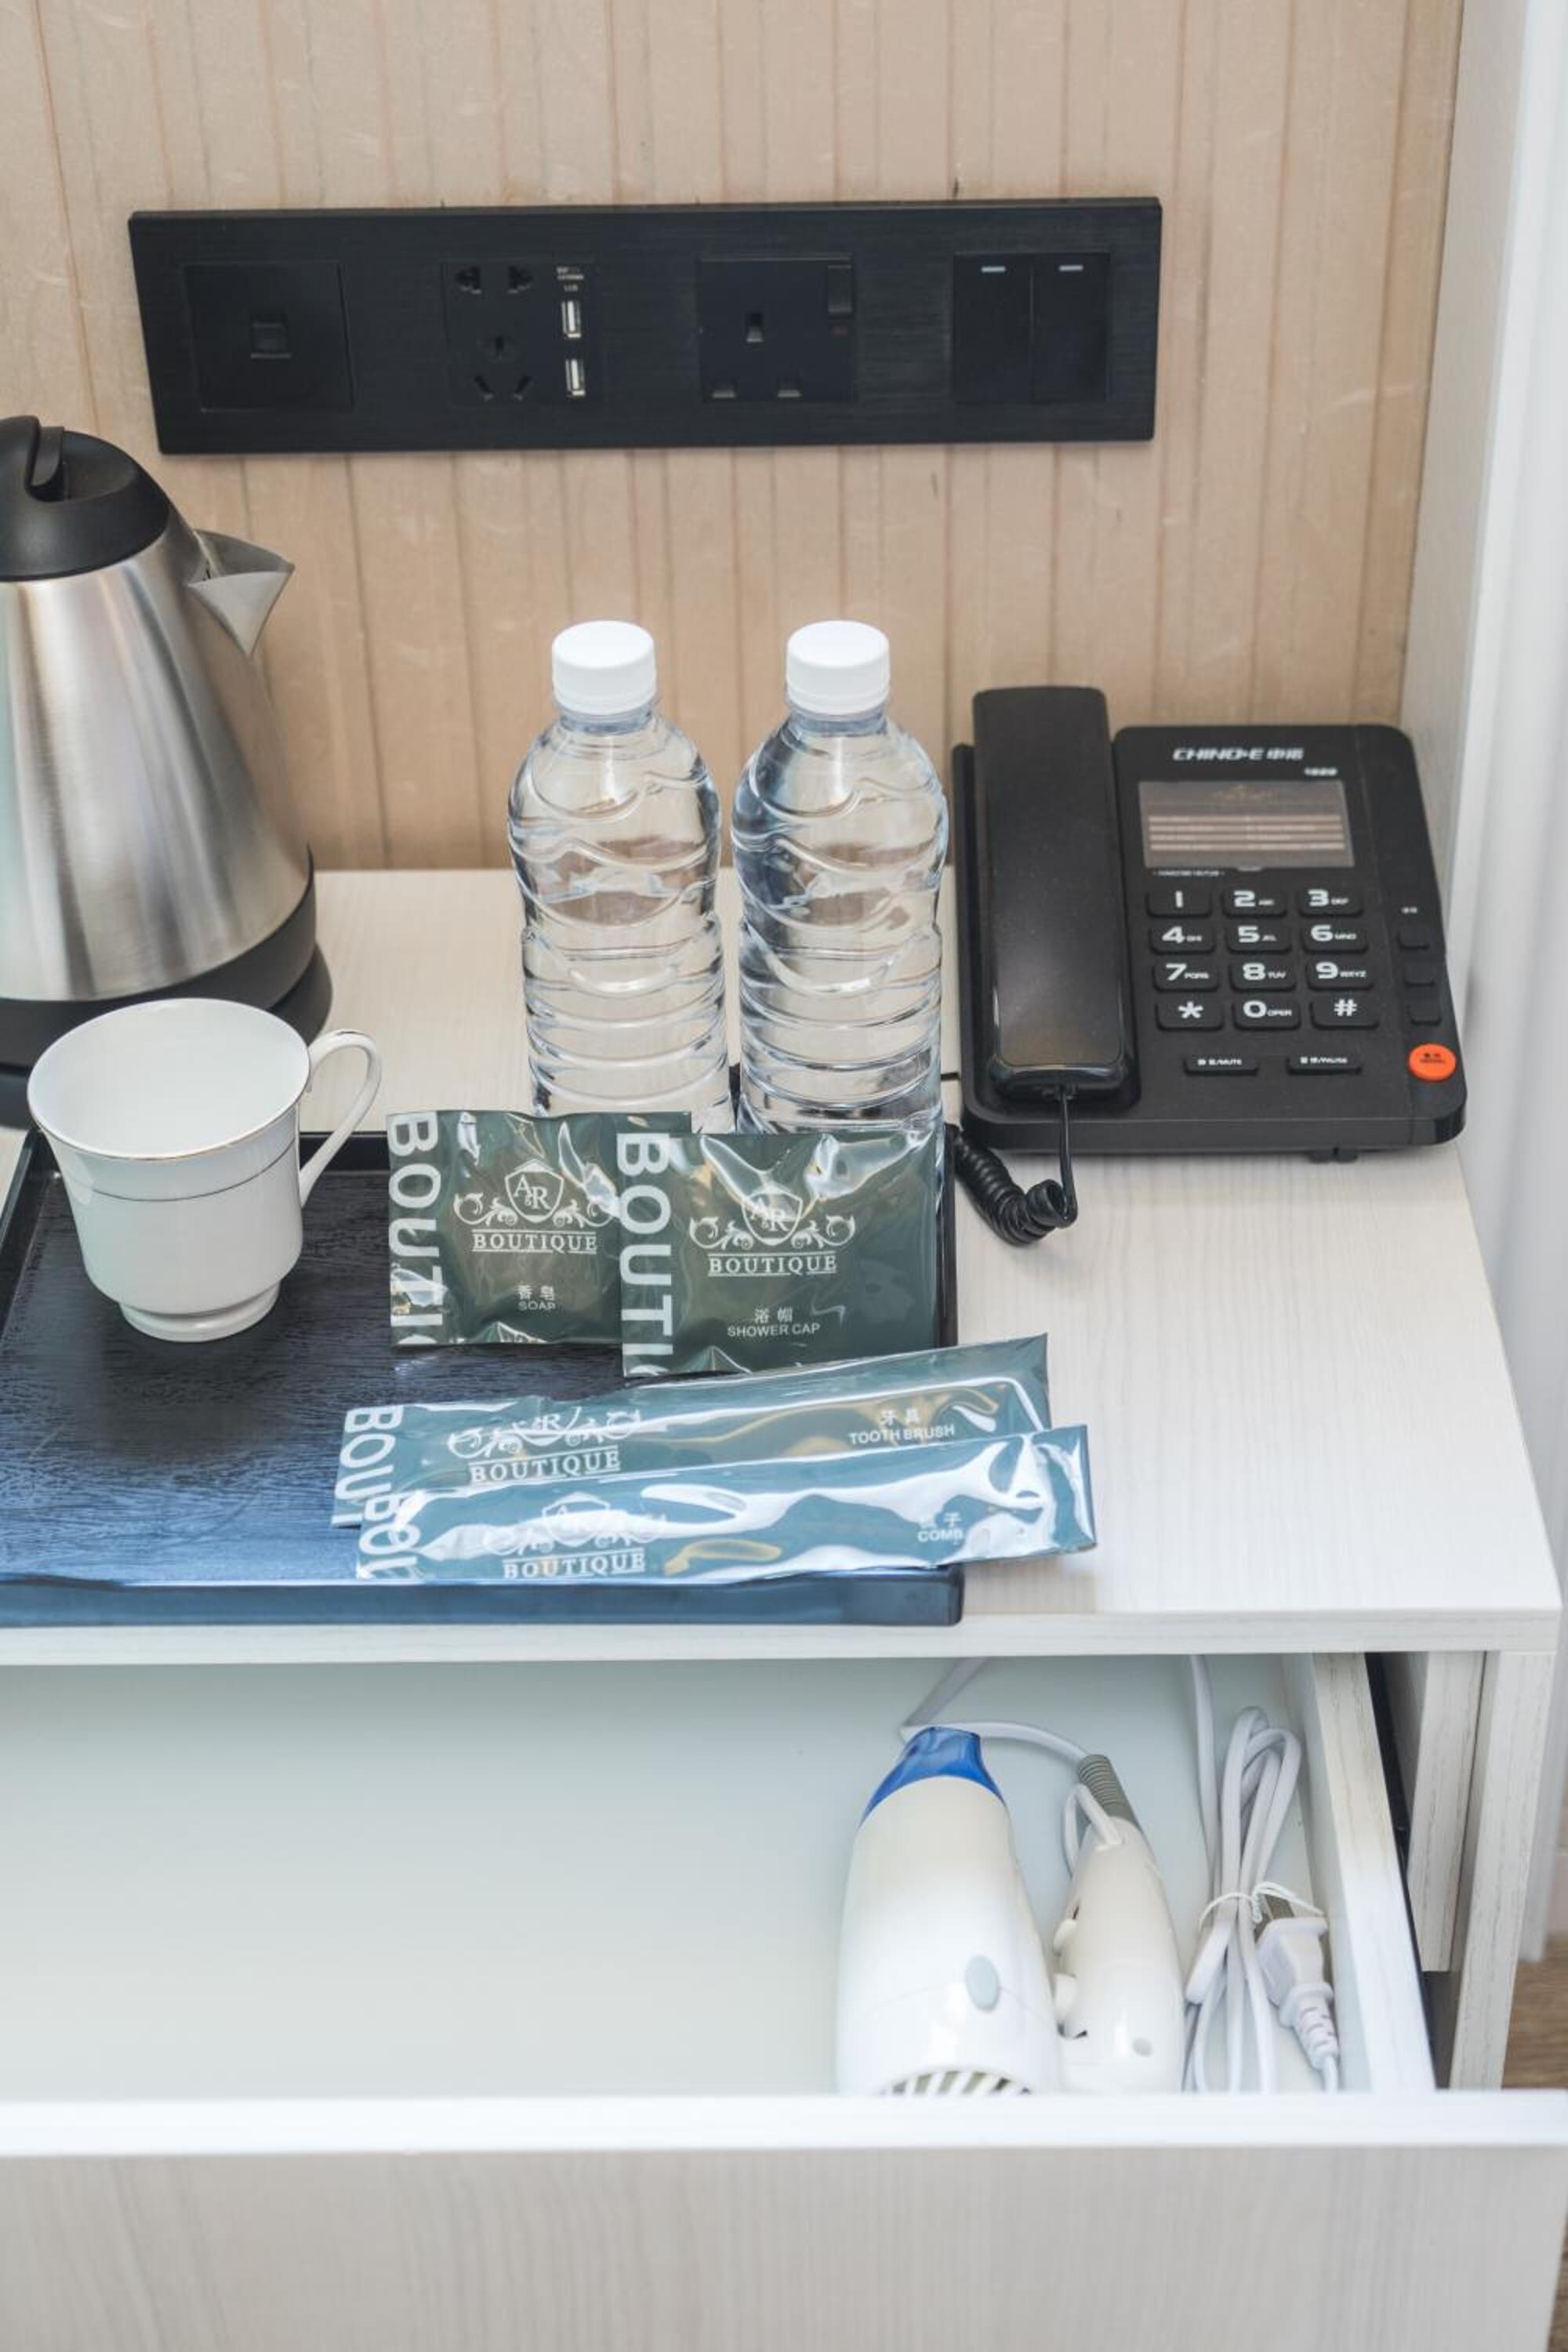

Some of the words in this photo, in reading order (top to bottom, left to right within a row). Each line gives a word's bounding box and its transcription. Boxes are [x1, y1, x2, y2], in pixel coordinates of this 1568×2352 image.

[1175, 890, 1183, 908] 1
[1233, 890, 1256, 907] 2
[1308, 888, 1330, 906] 3
[1161, 925, 1185, 944] 4
[1237, 924, 1260, 942] 5
[1310, 924, 1334, 942] 6
[1166, 962, 1188, 981] 7
[1242, 962, 1266, 981] 8
[1315, 961, 1339, 979] 9
[387, 1111, 444, 1345] BOUTI
[472, 1232, 597, 1254] BOUTIQUE
[616, 1133, 674, 1376] BOUTI
[709, 1254, 837, 1276] BOUTIQUE
[518, 1301, 557, 1312] SOAP
[727, 1323, 789, 1337] SHOWER
[791, 1322, 821, 1335] CAP
[849, 1429, 901, 1444] TOOTH
[903, 1423, 955, 1441] BRUSH
[470, 1448, 621, 1483] BOUTIQUE
[916, 1529, 964, 1544] COMB
[502, 1550, 646, 1580] BOUTIQUE
